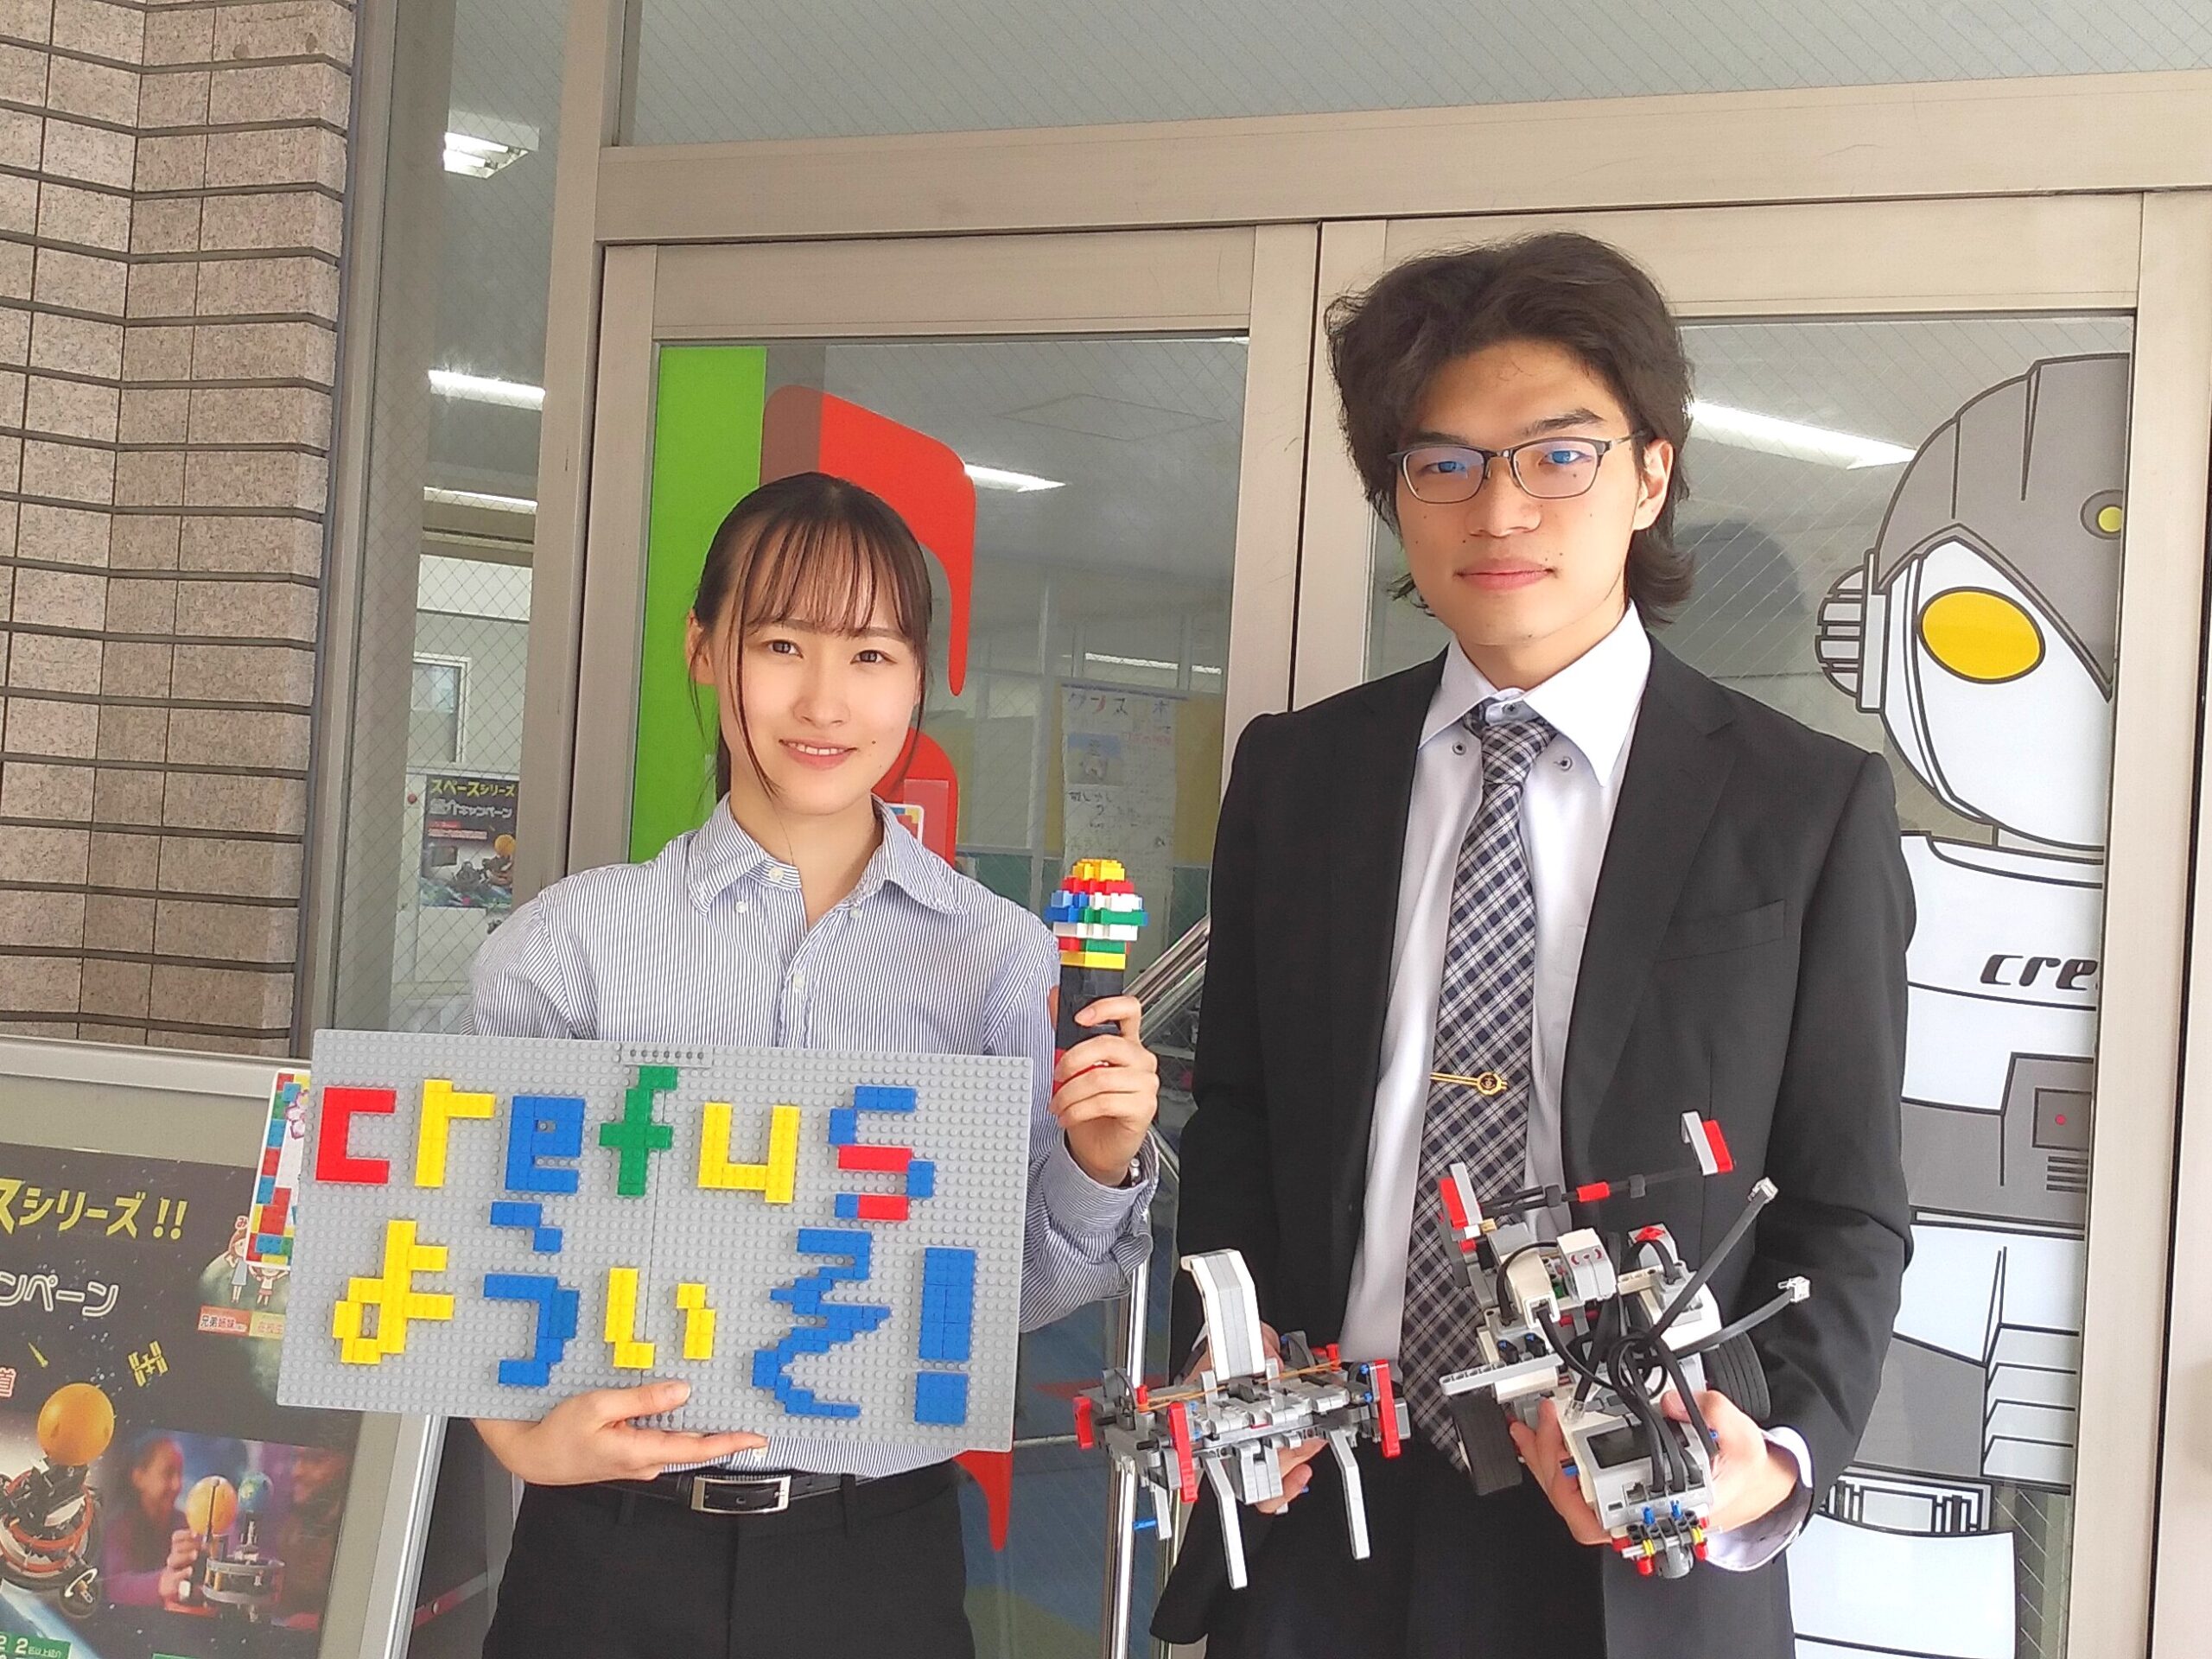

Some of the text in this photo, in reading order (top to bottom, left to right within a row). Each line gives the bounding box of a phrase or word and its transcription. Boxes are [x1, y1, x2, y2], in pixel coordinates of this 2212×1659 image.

[431, 779, 515, 797] スペースシリーズ
[1980, 953, 2099, 991] cre
[315, 1065, 935, 1222] crefus
